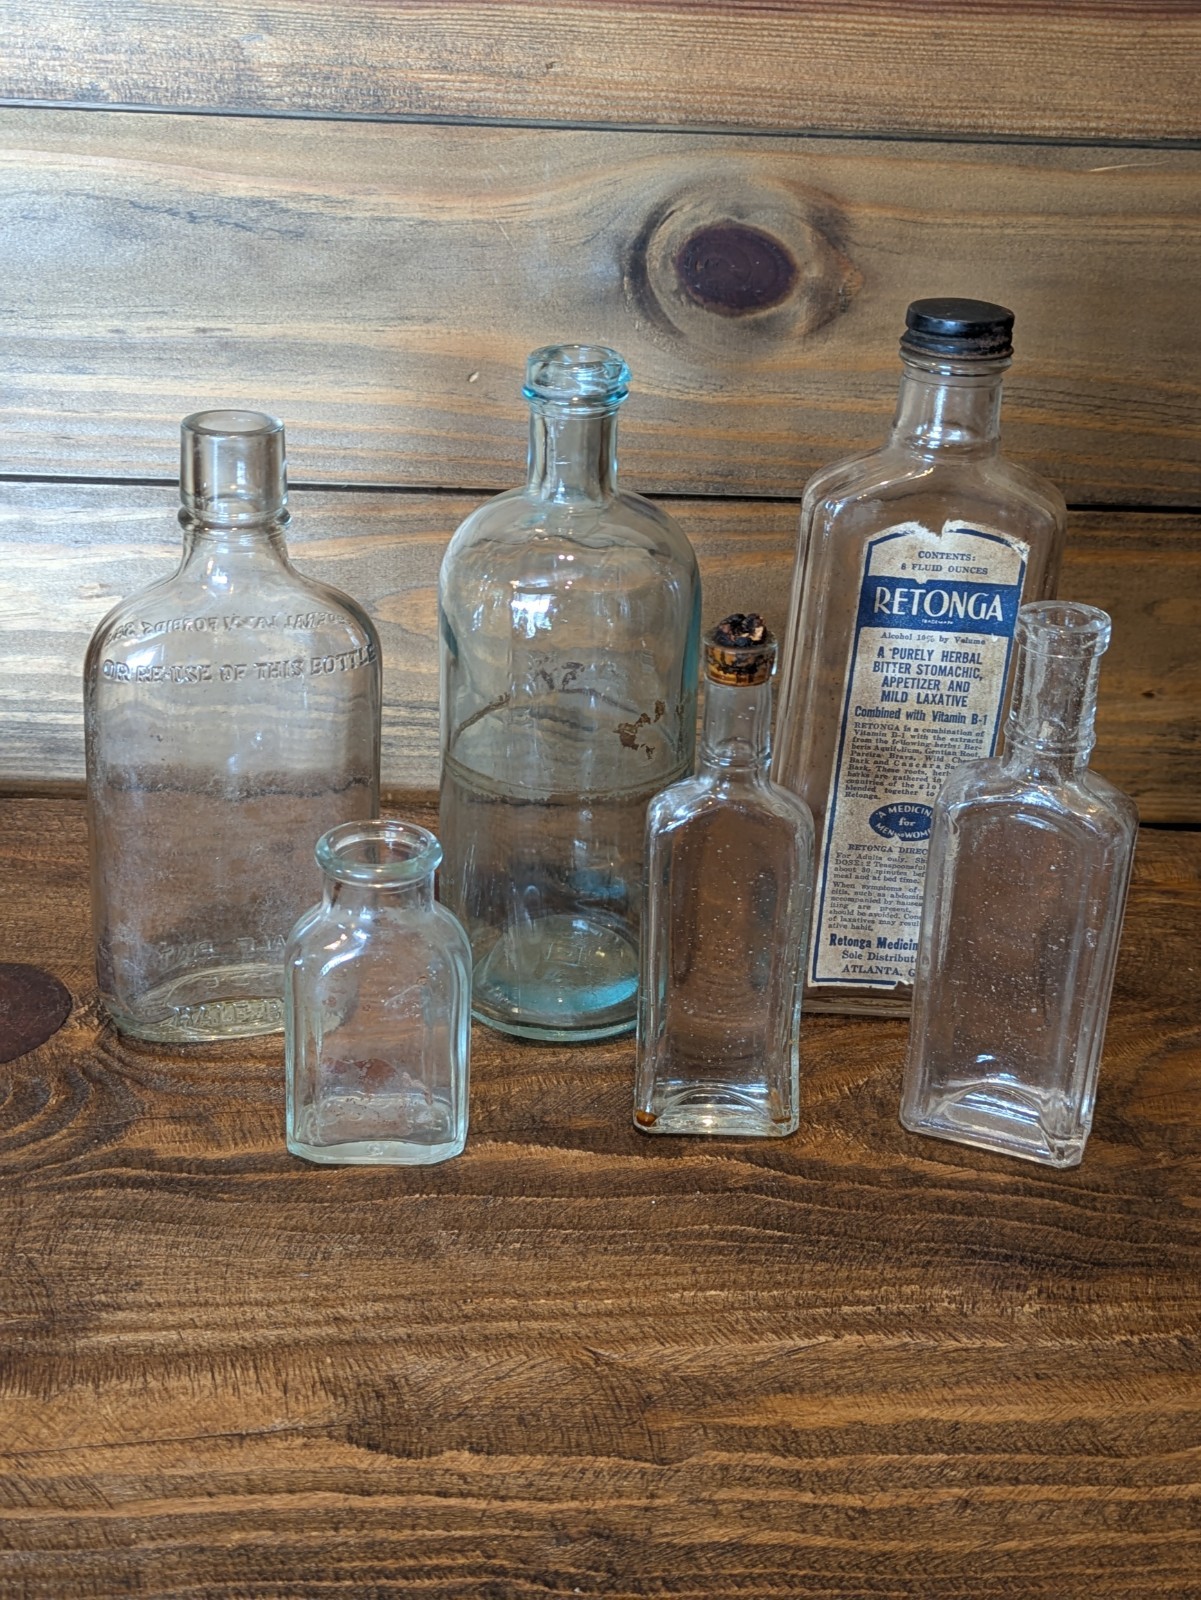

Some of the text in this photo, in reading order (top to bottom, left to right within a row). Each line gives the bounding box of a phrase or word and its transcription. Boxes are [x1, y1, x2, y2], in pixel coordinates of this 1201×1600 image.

[918, 551, 976, 561] CONTENTS:
[912, 563, 942, 572] FLUID
[948, 565, 988, 575] OUNCES
[874, 586, 1004, 622] RETONGA
[880, 632, 912, 640] Alcohol
[939, 635, 950, 644] by
[954, 636, 986, 645] Volume
[877, 646, 982, 664] A PURELY HERBAL
[219, 664, 247, 683] OF
[254, 659, 304, 680] THIS
[872, 661, 983, 681] BITTER STOMACHIC,
[881, 676, 970, 693] APPETIZER AND
[880, 690, 968, 707] MILD LAXATIVE
[855, 706, 988, 726] Combined with Vitamin B-1
[854, 722, 900, 732] RETONGA
[922, 728, 972, 736] combination
[854, 729, 886, 738] Vitamin
[924, 748, 956, 756] Gentian
[894, 760, 941, 769] Cascara
[846, 778, 884, 786] countries
[884, 788, 918, 796] together
[876, 805, 932, 818] A MEDICIN
[898, 817, 916, 826] for
[876, 823, 894, 836] MEN
[848, 844, 928, 855] RETONGA DIREC
[862, 884, 902, 892] symptoms
[890, 892, 924, 900] abdomin
[840, 916, 876, 924] laxatives
[829, 933, 918, 950] Retonga Medicin
[842, 949, 863, 960] Sole
[908, 968, 916, 977] G
